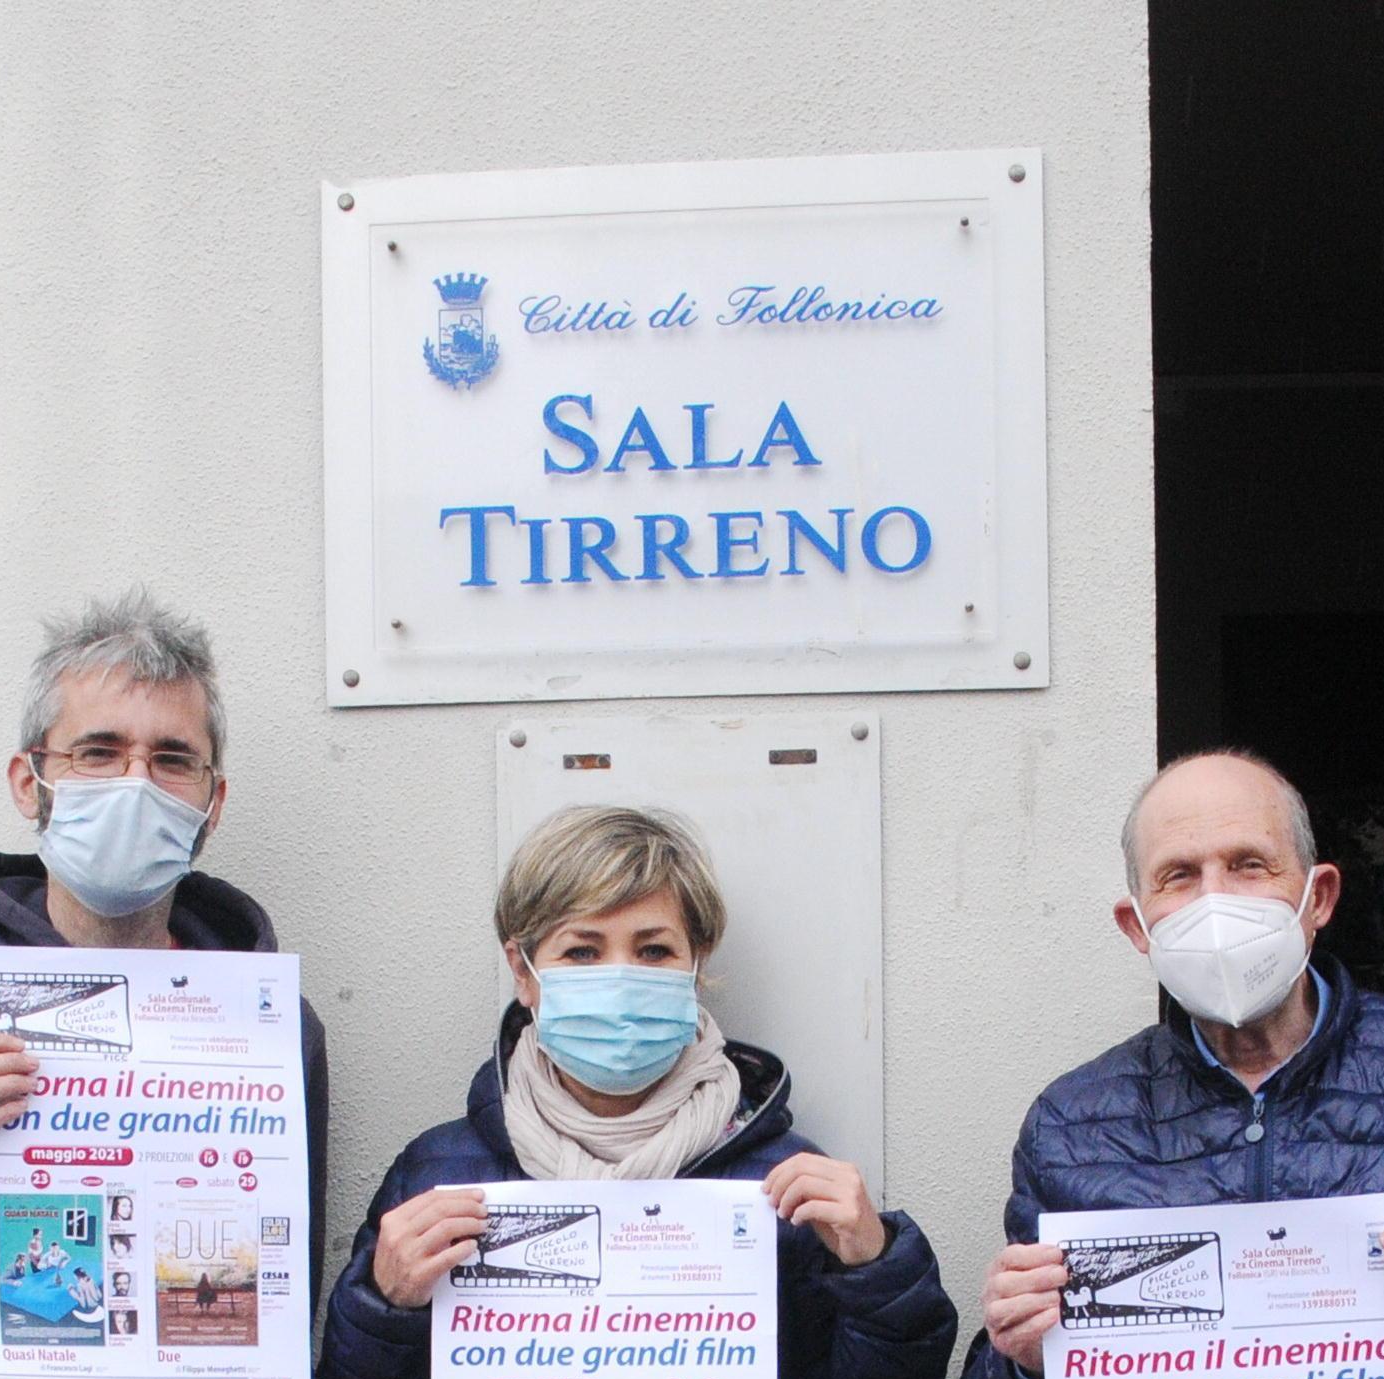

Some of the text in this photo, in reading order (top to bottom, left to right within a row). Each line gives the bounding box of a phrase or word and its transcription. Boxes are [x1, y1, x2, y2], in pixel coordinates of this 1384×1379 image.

[518, 286, 943, 334] Città di Follonica
[543, 394, 822, 475] SALA
[439, 506, 933, 587] TIRRENO
[147, 993, 211, 1004] Sala Comunale
[154, 1004, 185, 1013] Cinema
[31, 1071, 284, 1103] orna il cinemino
[50, 1103, 110, 1131] due
[118, 1106, 221, 1140] grandi
[229, 1107, 286, 1135] film
[31, 1147, 124, 1164] maggio 2021
[138, 1152, 144, 1162] 2
[145, 1152, 194, 1163] PROIEZIONI
[32, 1174, 48, 1184] 23
[206, 1177, 256, 1187] sabato 29
[620, 1222, 684, 1232] Sala Comunale
[175, 1220, 238, 1260] DUE
[625, 1233, 658, 1242] Cinema
[1242, 1246, 1313, 1259] Sala Comunale
[1249, 1258, 1284, 1269] Cinema
[1149, 1260, 1195, 1284] PICCOLO
[1148, 1270, 1209, 1293] CINECLUB
[1152, 1289, 1206, 1301] TIRRENO
[451, 1304, 757, 1333] Ritorna il cinemino
[1191, 1322, 1218, 1331] FICC
[2, 1348, 76, 1361] Quasi Natale
[158, 1350, 181, 1362] Due
[450, 1337, 756, 1374] con due grandi film
[1065, 1347, 1195, 1379] Ritorna
[1205, 1340, 1226, 1370] il
